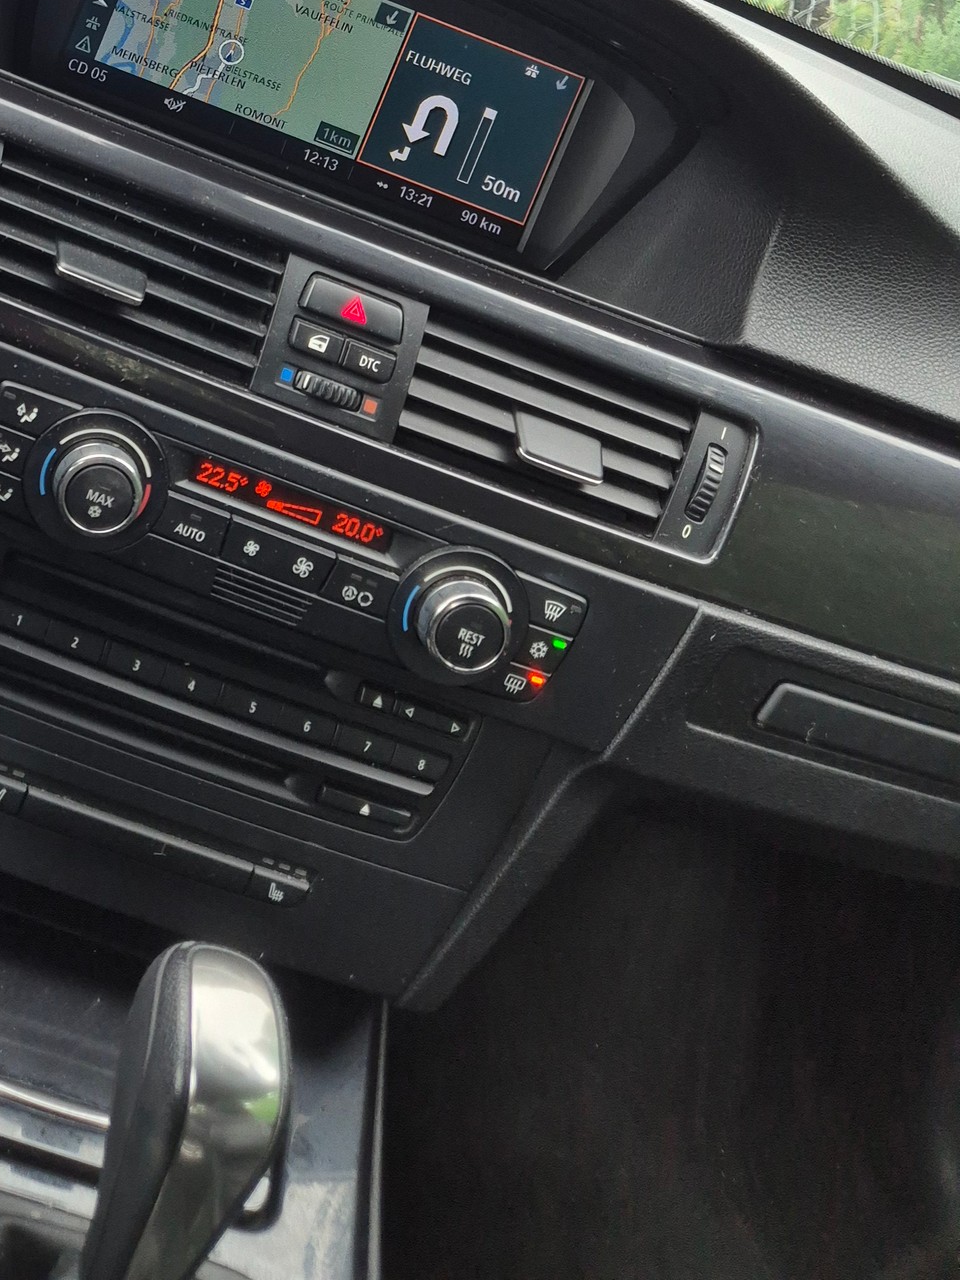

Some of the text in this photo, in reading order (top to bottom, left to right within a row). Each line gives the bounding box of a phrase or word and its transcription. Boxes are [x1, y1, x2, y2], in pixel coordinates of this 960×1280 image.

[295, 3, 354, 34] VAUFFELIN
[323, 0, 355, 18] ROUTE
[68, 58, 109, 83] CD 05
[110, 45, 179, 79] MEINISBERG
[405, 49, 473, 86] FLUHWEG
[189, 61, 247, 90] PIETERLEN
[225, 64, 282, 93] BIELSTRASSE
[234, 102, 288, 130] ROMONT
[303, 148, 340, 172] 12:13
[399, 185, 434, 209] 13:21
[481, 174, 522, 204] 50m
[460, 209, 503, 236] 90 km
[358, 354, 382, 373] DTC
[85, 488, 116, 509] MAX
[173, 522, 207, 543] AUTO
[681, 524, 692, 539] 0
[15, 613, 24, 627] 1
[70, 636, 81, 649] 2
[457, 627, 487, 648] REST
[131, 658, 142, 672] 3
[186, 679, 197, 693] 4
[248, 701, 259, 715] 5
[302, 720, 313, 733] 6
[362, 740, 373, 753] 7
[416, 758, 427, 772] 8
